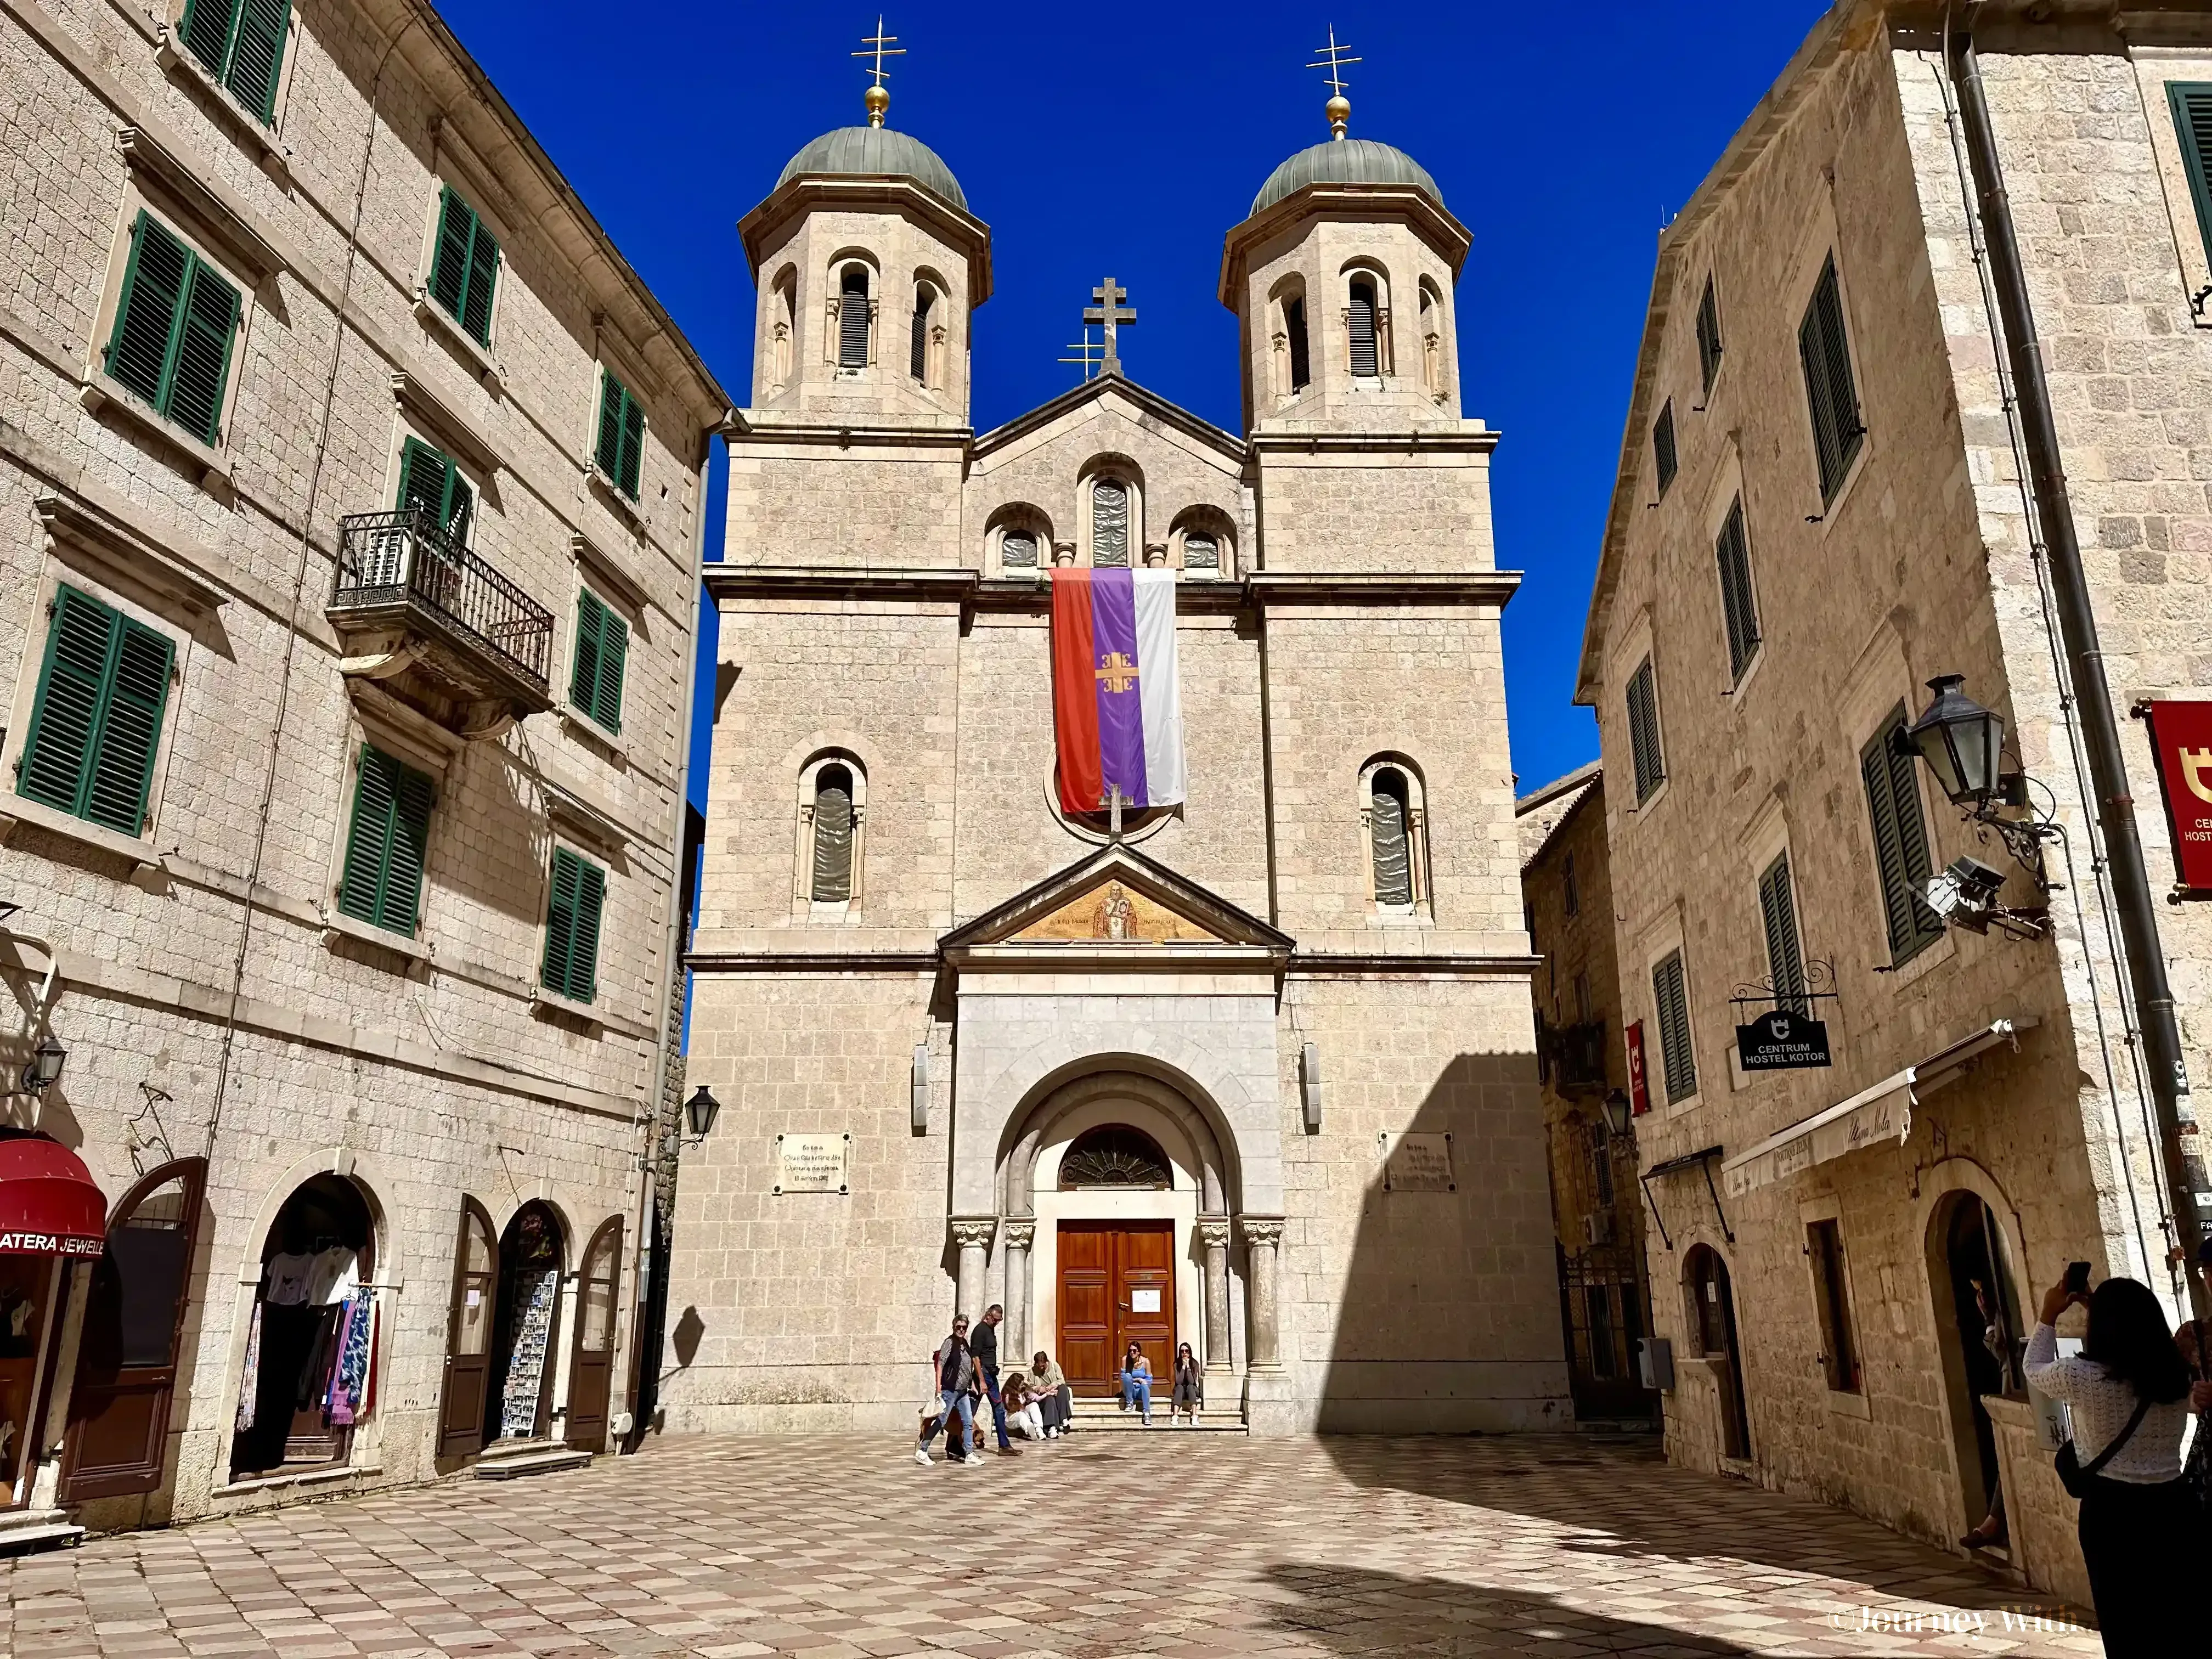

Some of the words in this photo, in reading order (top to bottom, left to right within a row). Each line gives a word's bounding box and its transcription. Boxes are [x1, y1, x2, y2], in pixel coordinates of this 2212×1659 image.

[2185, 831, 2212, 841] HOST
[1758, 1043, 1810, 1053] CENTRUM
[1746, 1054, 1787, 1064] HOSTEL
[1790, 1052, 1826, 1062] KOTOR
[0, 1234, 57, 1251] ATERA
